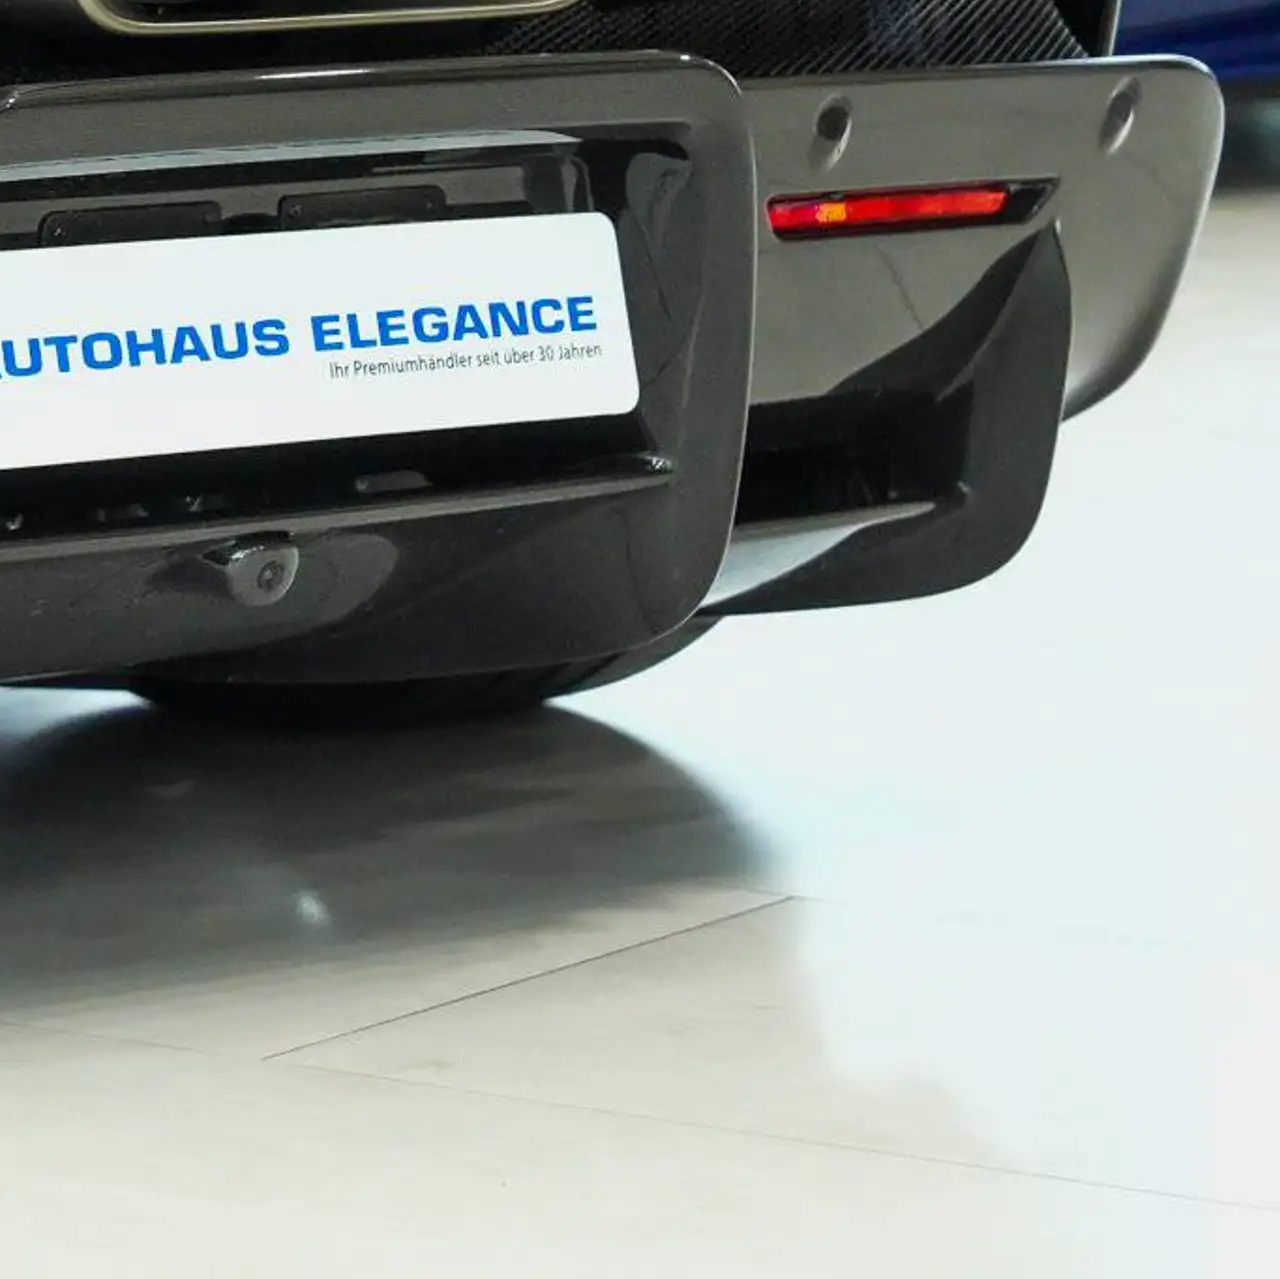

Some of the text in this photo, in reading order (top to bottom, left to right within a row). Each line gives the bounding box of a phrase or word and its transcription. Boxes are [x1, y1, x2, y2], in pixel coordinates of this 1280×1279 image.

[311, 295, 596, 353] ELEGANCE
[329, 344, 602, 379] Ihr Premiumhändler seit über 30 Jahren
